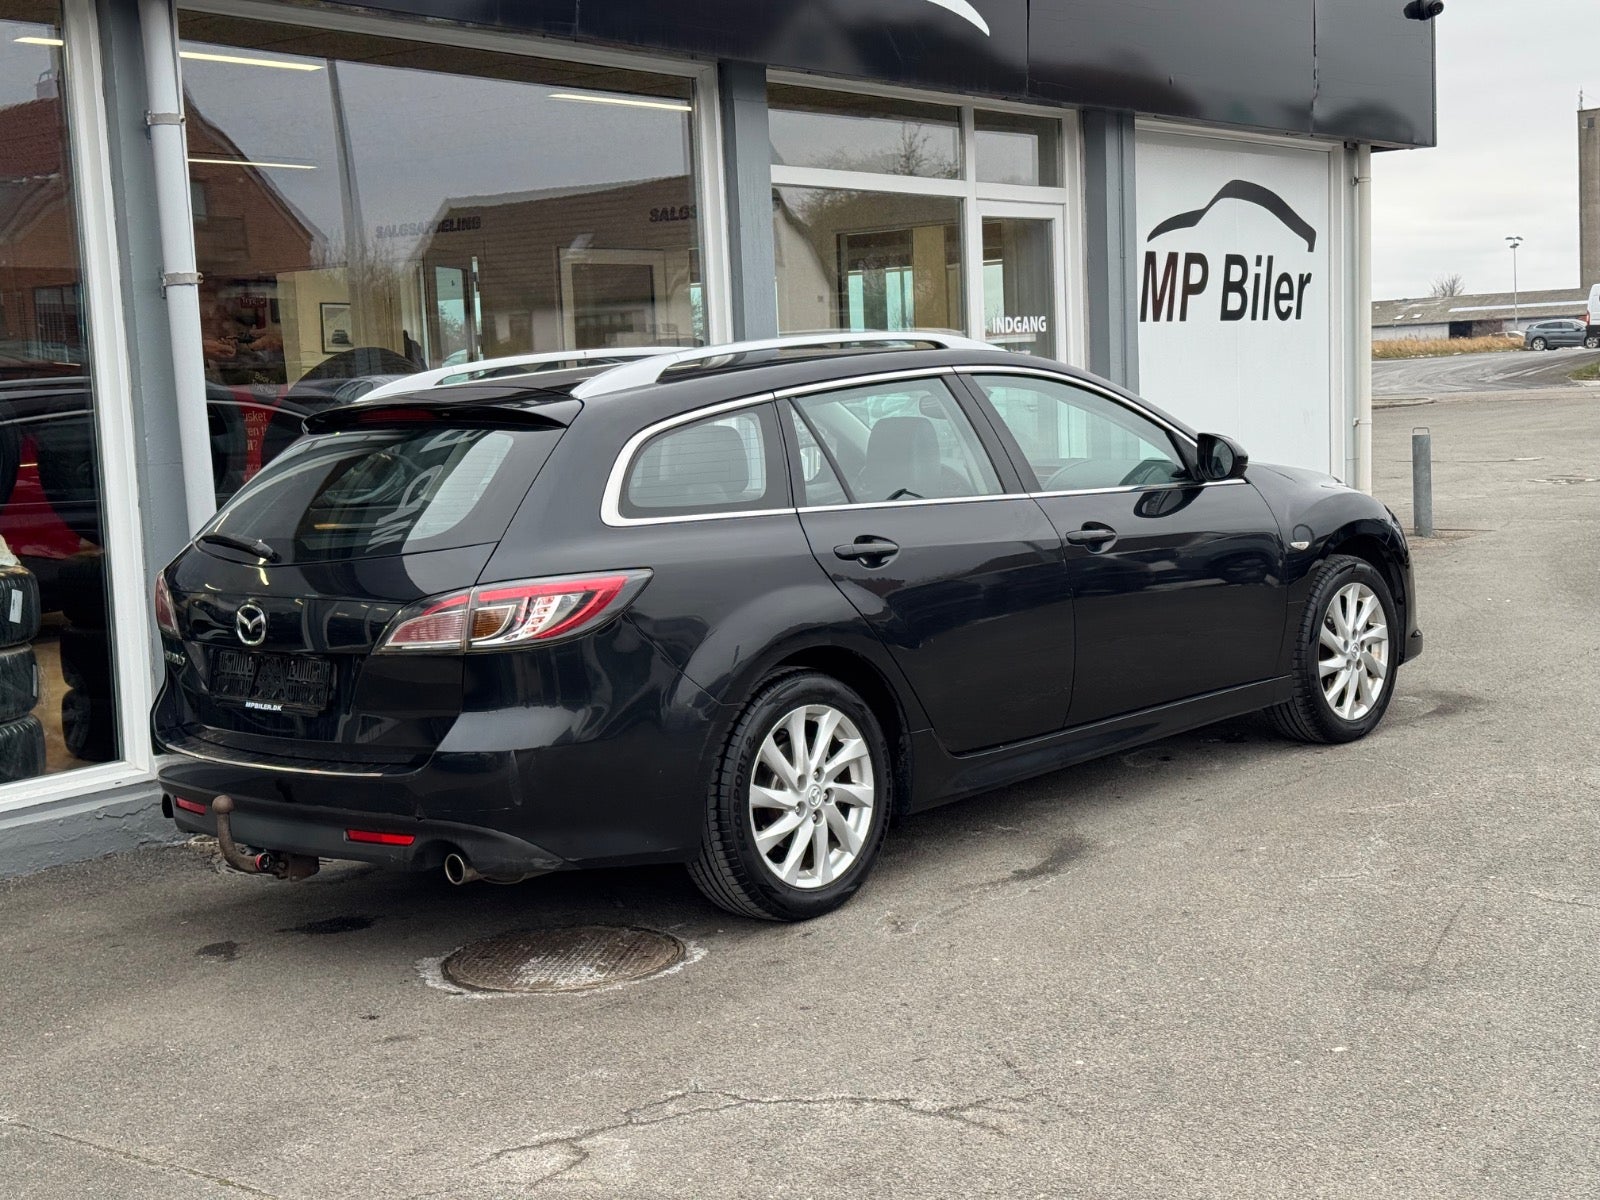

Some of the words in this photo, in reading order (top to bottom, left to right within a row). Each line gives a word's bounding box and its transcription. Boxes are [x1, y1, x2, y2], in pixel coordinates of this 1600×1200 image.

[1140, 251, 1209, 322] MP
[1220, 254, 1312, 321] Biler
[992, 316, 1047, 333] INDGANG
[245, 702, 282, 712] MPBILER.DK
